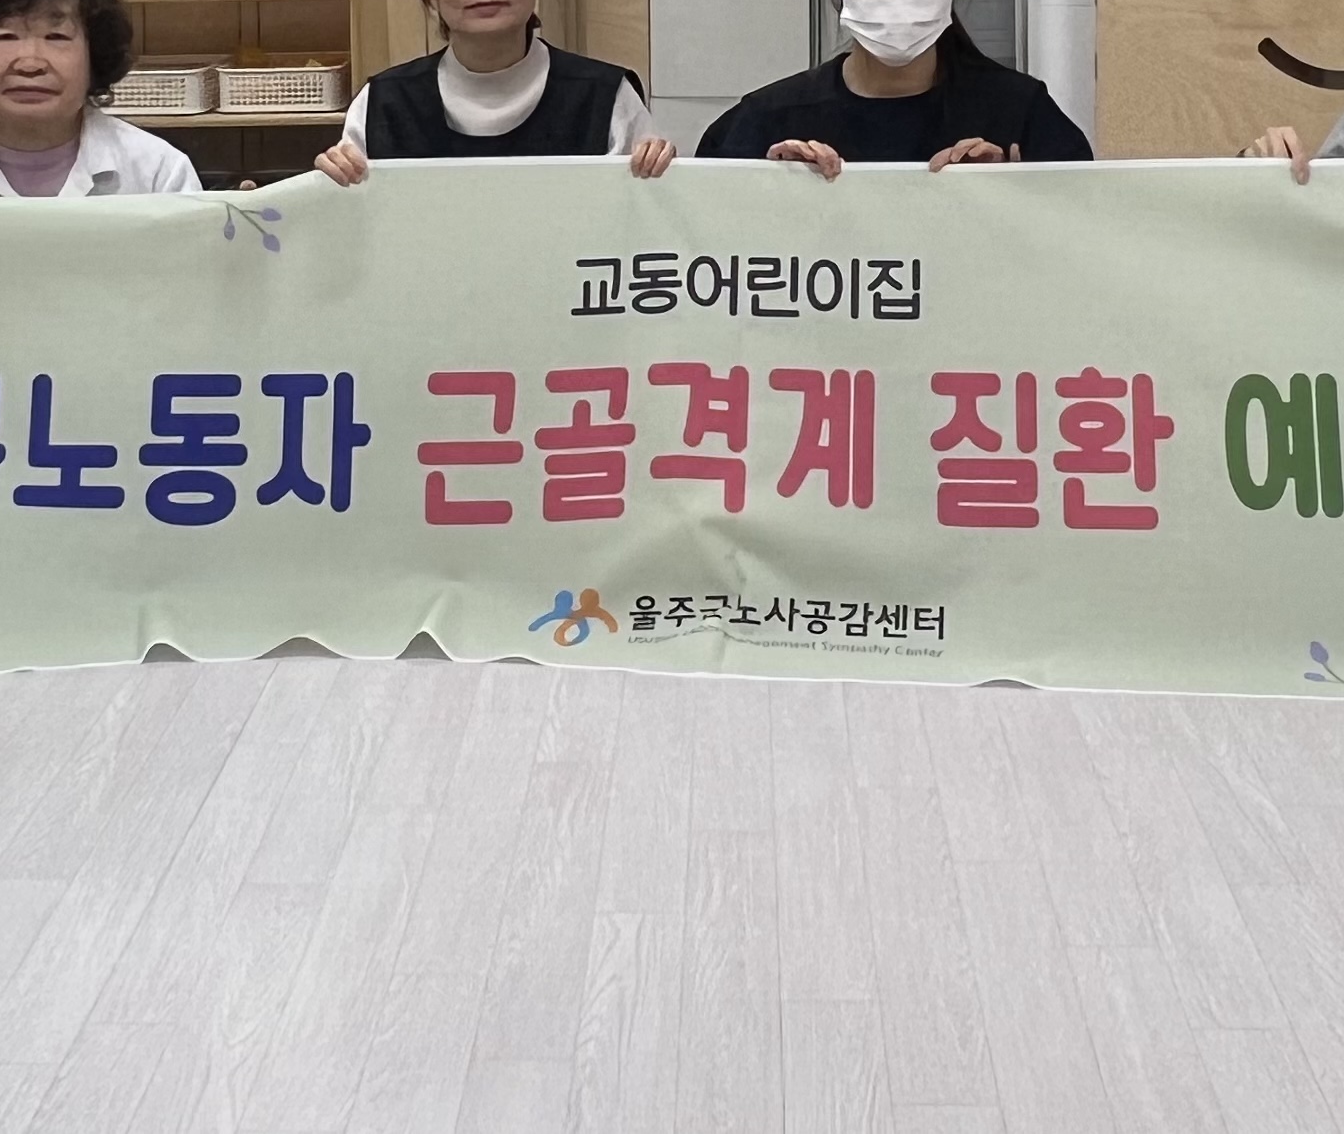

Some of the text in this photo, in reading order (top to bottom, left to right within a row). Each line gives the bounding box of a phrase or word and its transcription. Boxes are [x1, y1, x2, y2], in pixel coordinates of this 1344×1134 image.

[570, 252, 922, 320] 교동어린이집
[417, 362, 876, 526] 근골격계
[930, 367, 1175, 530] 질환
